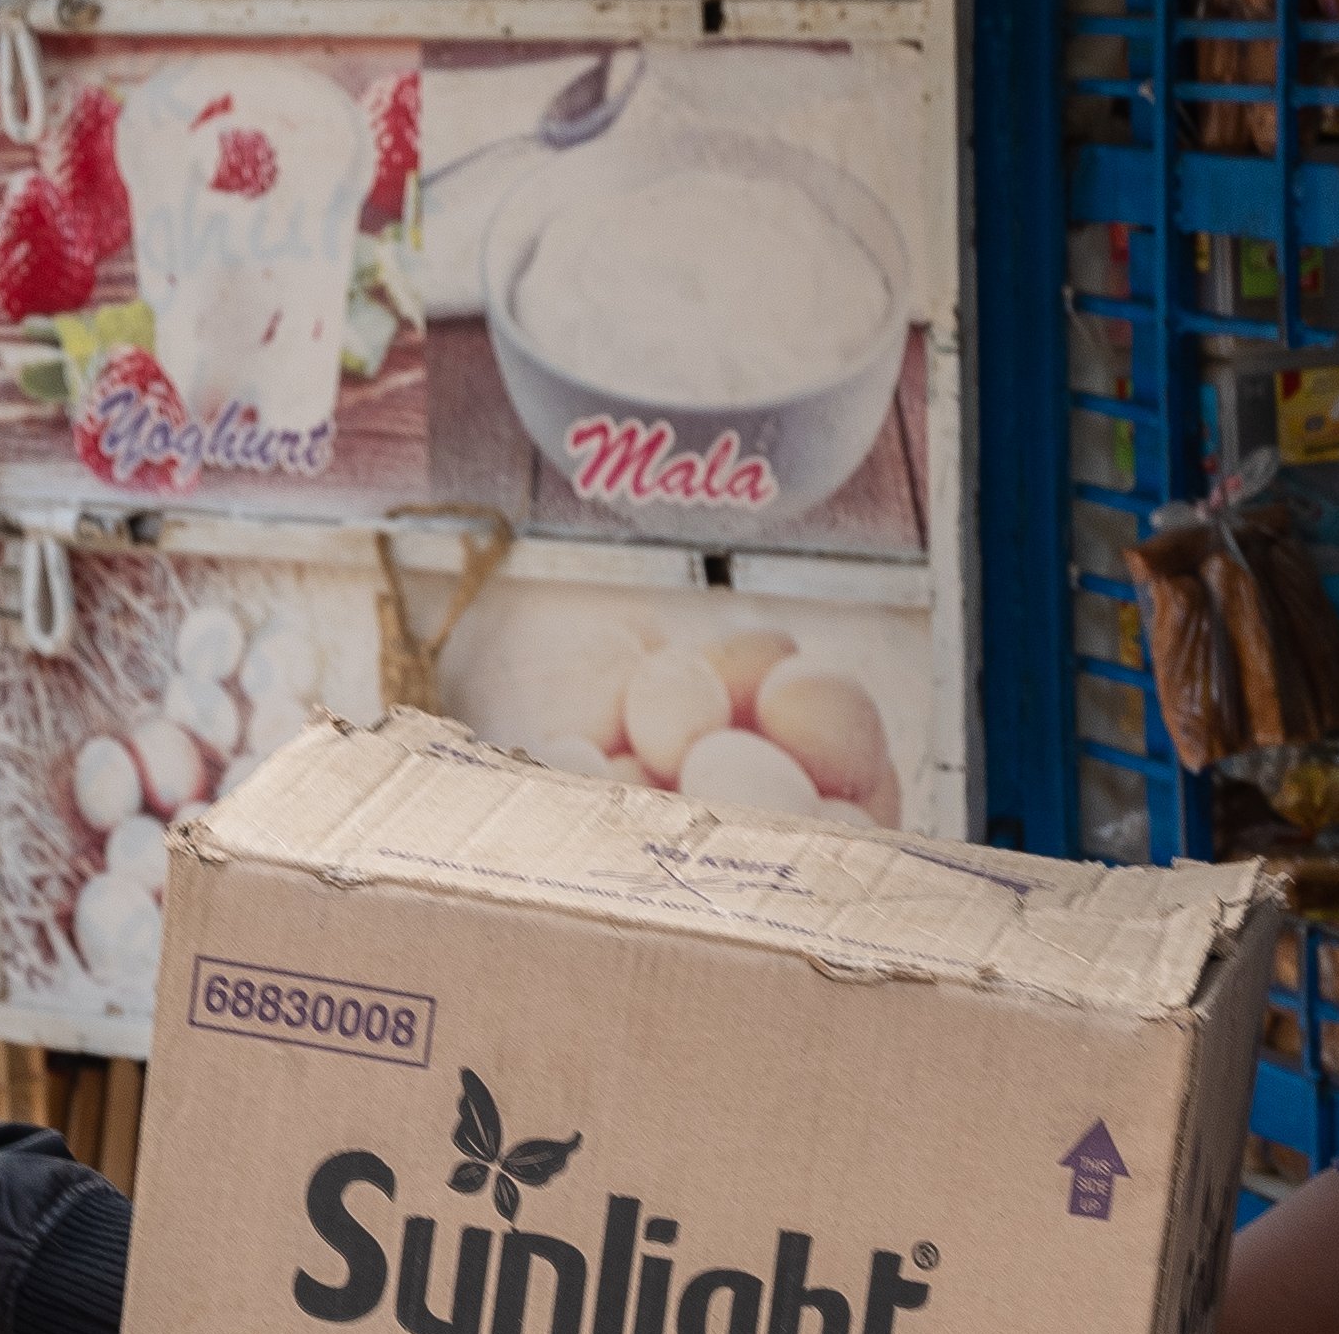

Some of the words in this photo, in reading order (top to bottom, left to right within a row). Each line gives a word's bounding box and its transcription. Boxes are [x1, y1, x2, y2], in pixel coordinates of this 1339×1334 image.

[94, 386, 337, 484] Yoghurt
[568, 417, 773, 506] Mala
[204, 974, 417, 1047] 68830008
